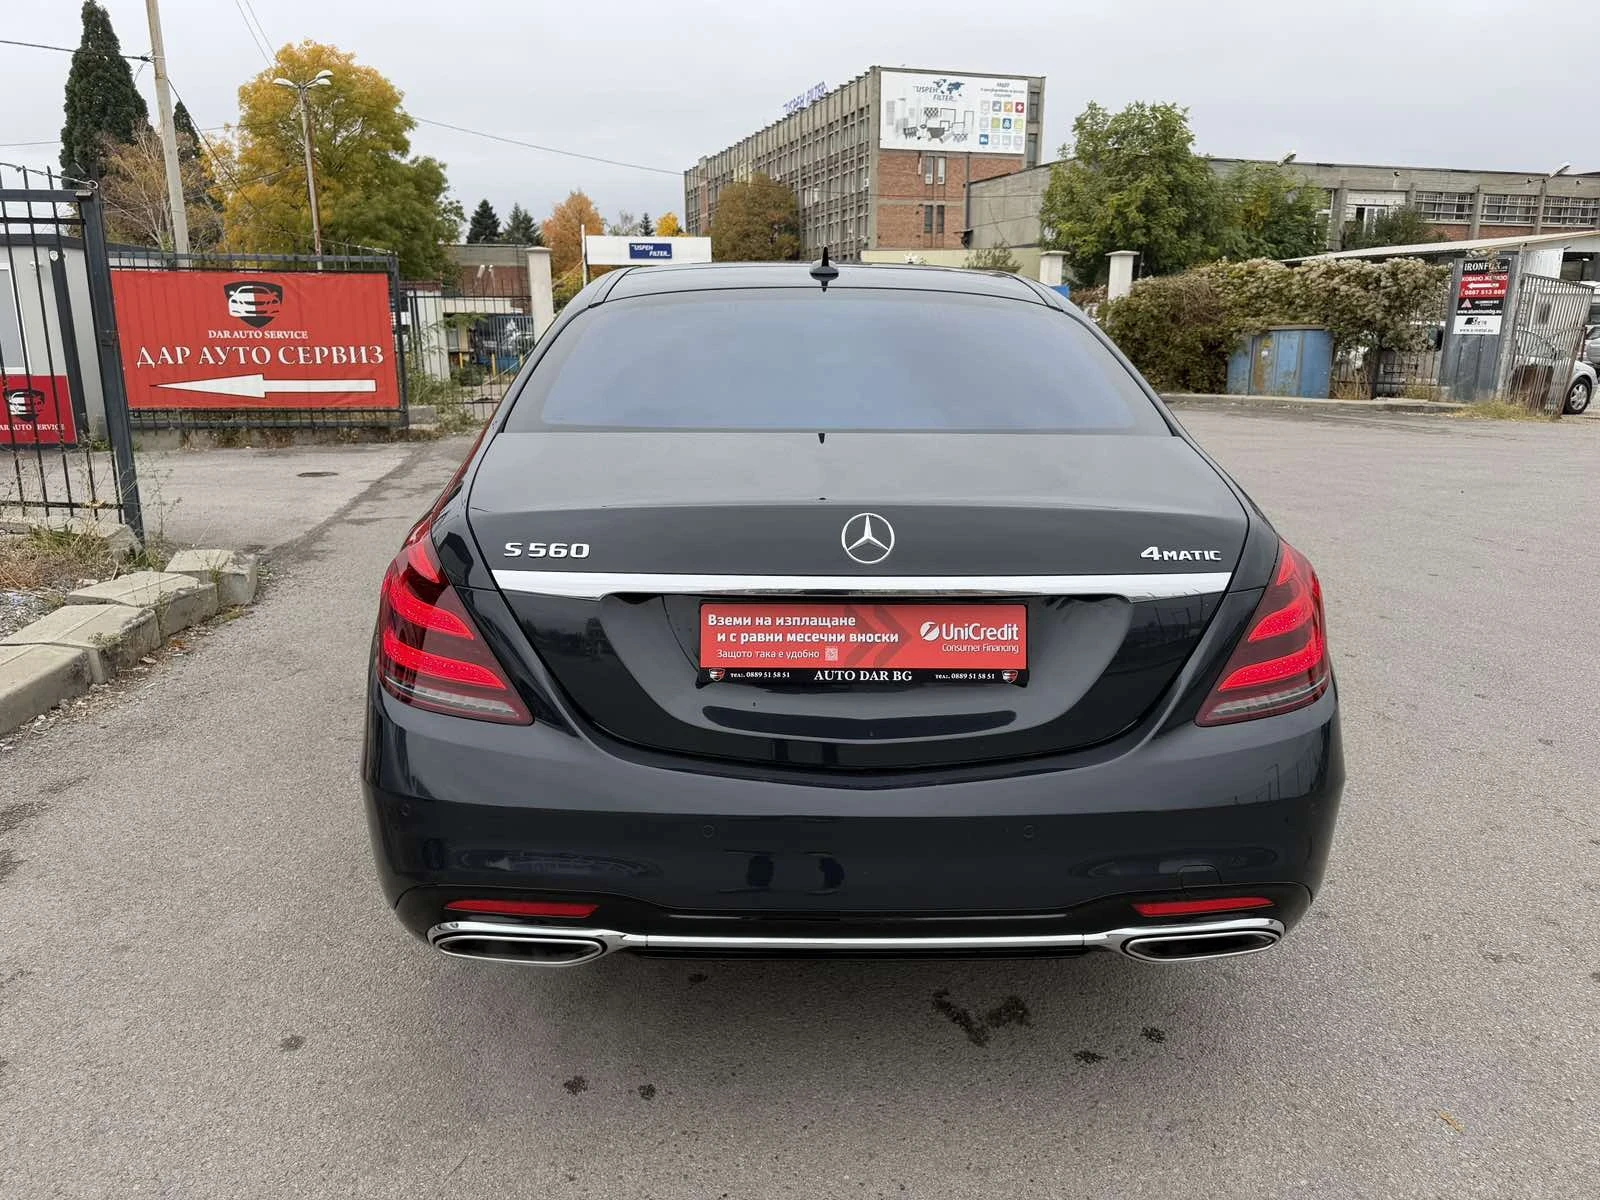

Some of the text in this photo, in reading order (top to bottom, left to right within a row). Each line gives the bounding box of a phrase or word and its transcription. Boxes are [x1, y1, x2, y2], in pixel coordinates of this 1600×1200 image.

[208, 330, 308, 340] DAR AUTO SERVICE
[137, 345, 384, 369] ДАР АУТО СЕРВИЗ
[504, 542, 590, 558] S 560
[1140, 546, 1222, 561] 4MATIC
[708, 614, 856, 628] Вземи на изплащане
[942, 623, 1019, 641] UniCredit
[717, 633, 899, 645] и с равни месечни вноски
[717, 649, 752, 659] Защото
[755, 650, 776, 658] така
[786, 649, 820, 660] удобно
[942, 643, 1019, 654] Consumer Financing
[814, 670, 913, 681] AUTO DAR BG
